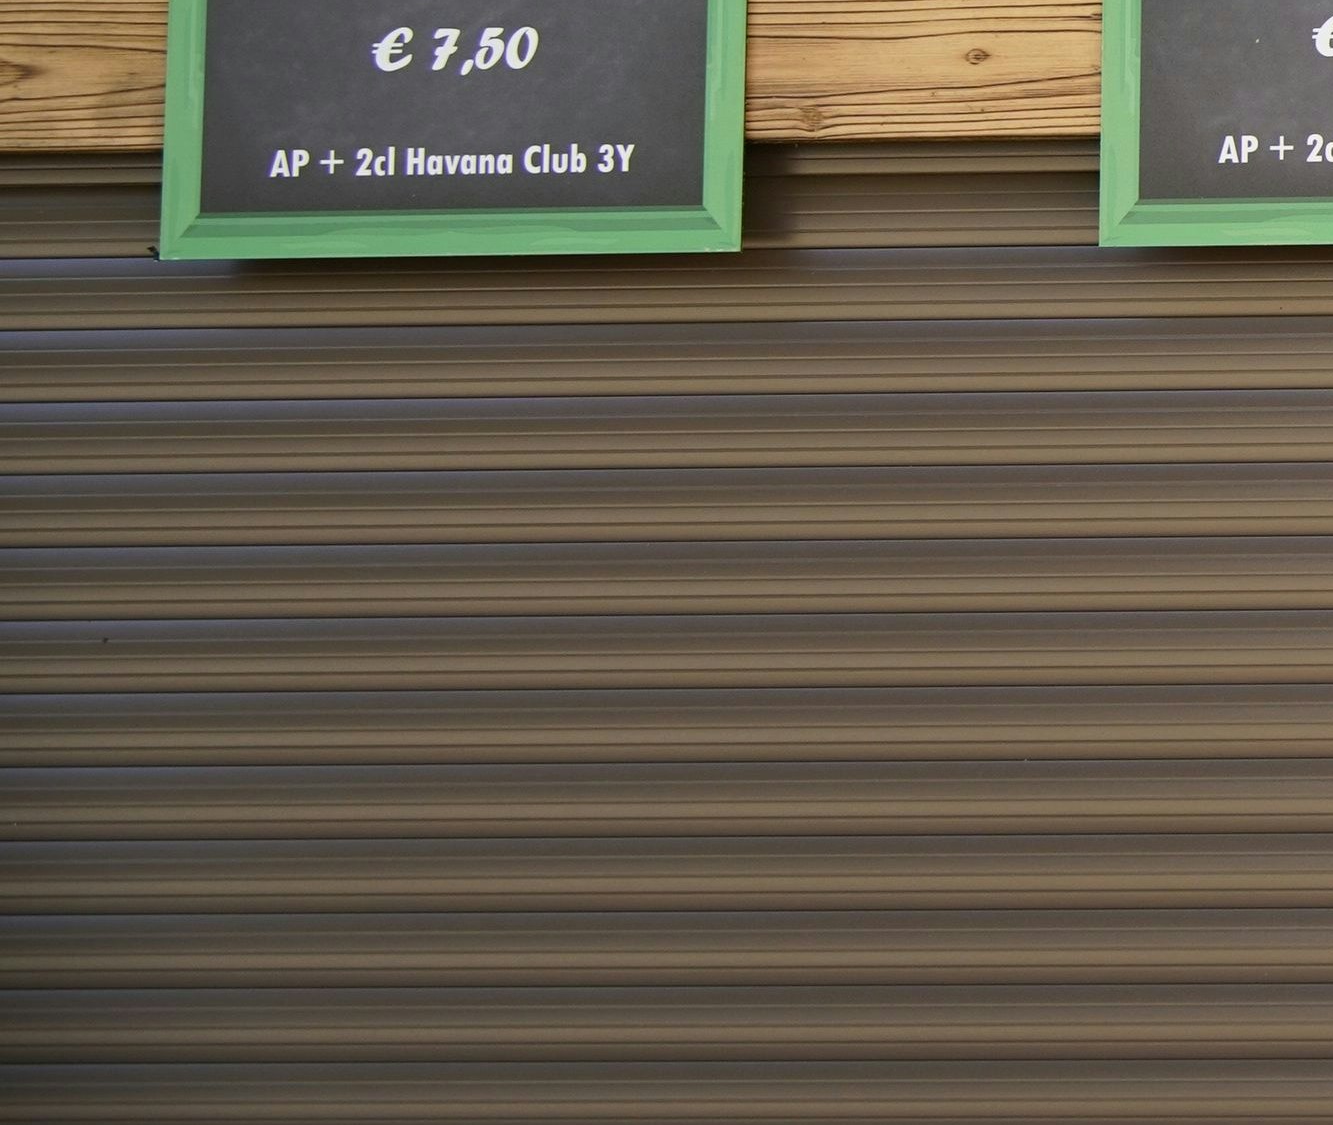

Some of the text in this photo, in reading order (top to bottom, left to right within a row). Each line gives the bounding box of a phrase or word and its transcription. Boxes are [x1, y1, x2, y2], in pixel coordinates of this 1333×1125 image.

[371, 26, 539, 76] € 7,50
[269, 143, 635, 178] AP + 2cl Havana Club 3Y
[1218, 134, 1259, 164] AP
[1269, 135, 1295, 161] +
